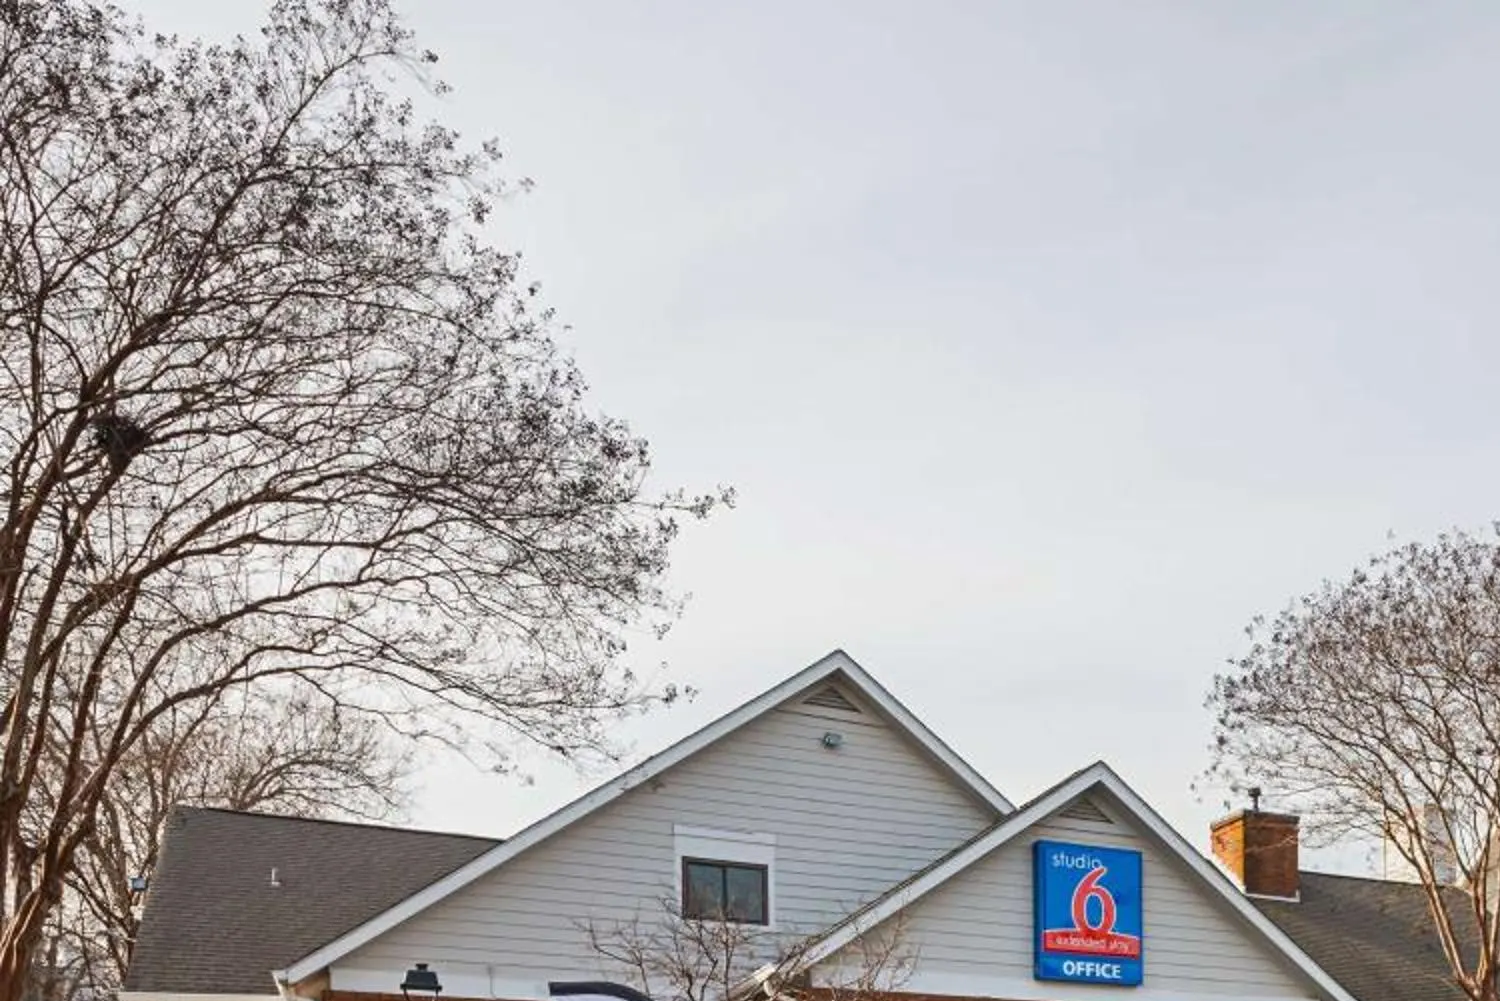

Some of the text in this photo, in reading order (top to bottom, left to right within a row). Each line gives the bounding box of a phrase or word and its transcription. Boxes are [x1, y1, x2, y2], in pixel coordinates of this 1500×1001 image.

[1051, 851, 1102, 868] studio
[1071, 867, 1117, 932] 6
[1063, 960, 1122, 979] OFFICE
